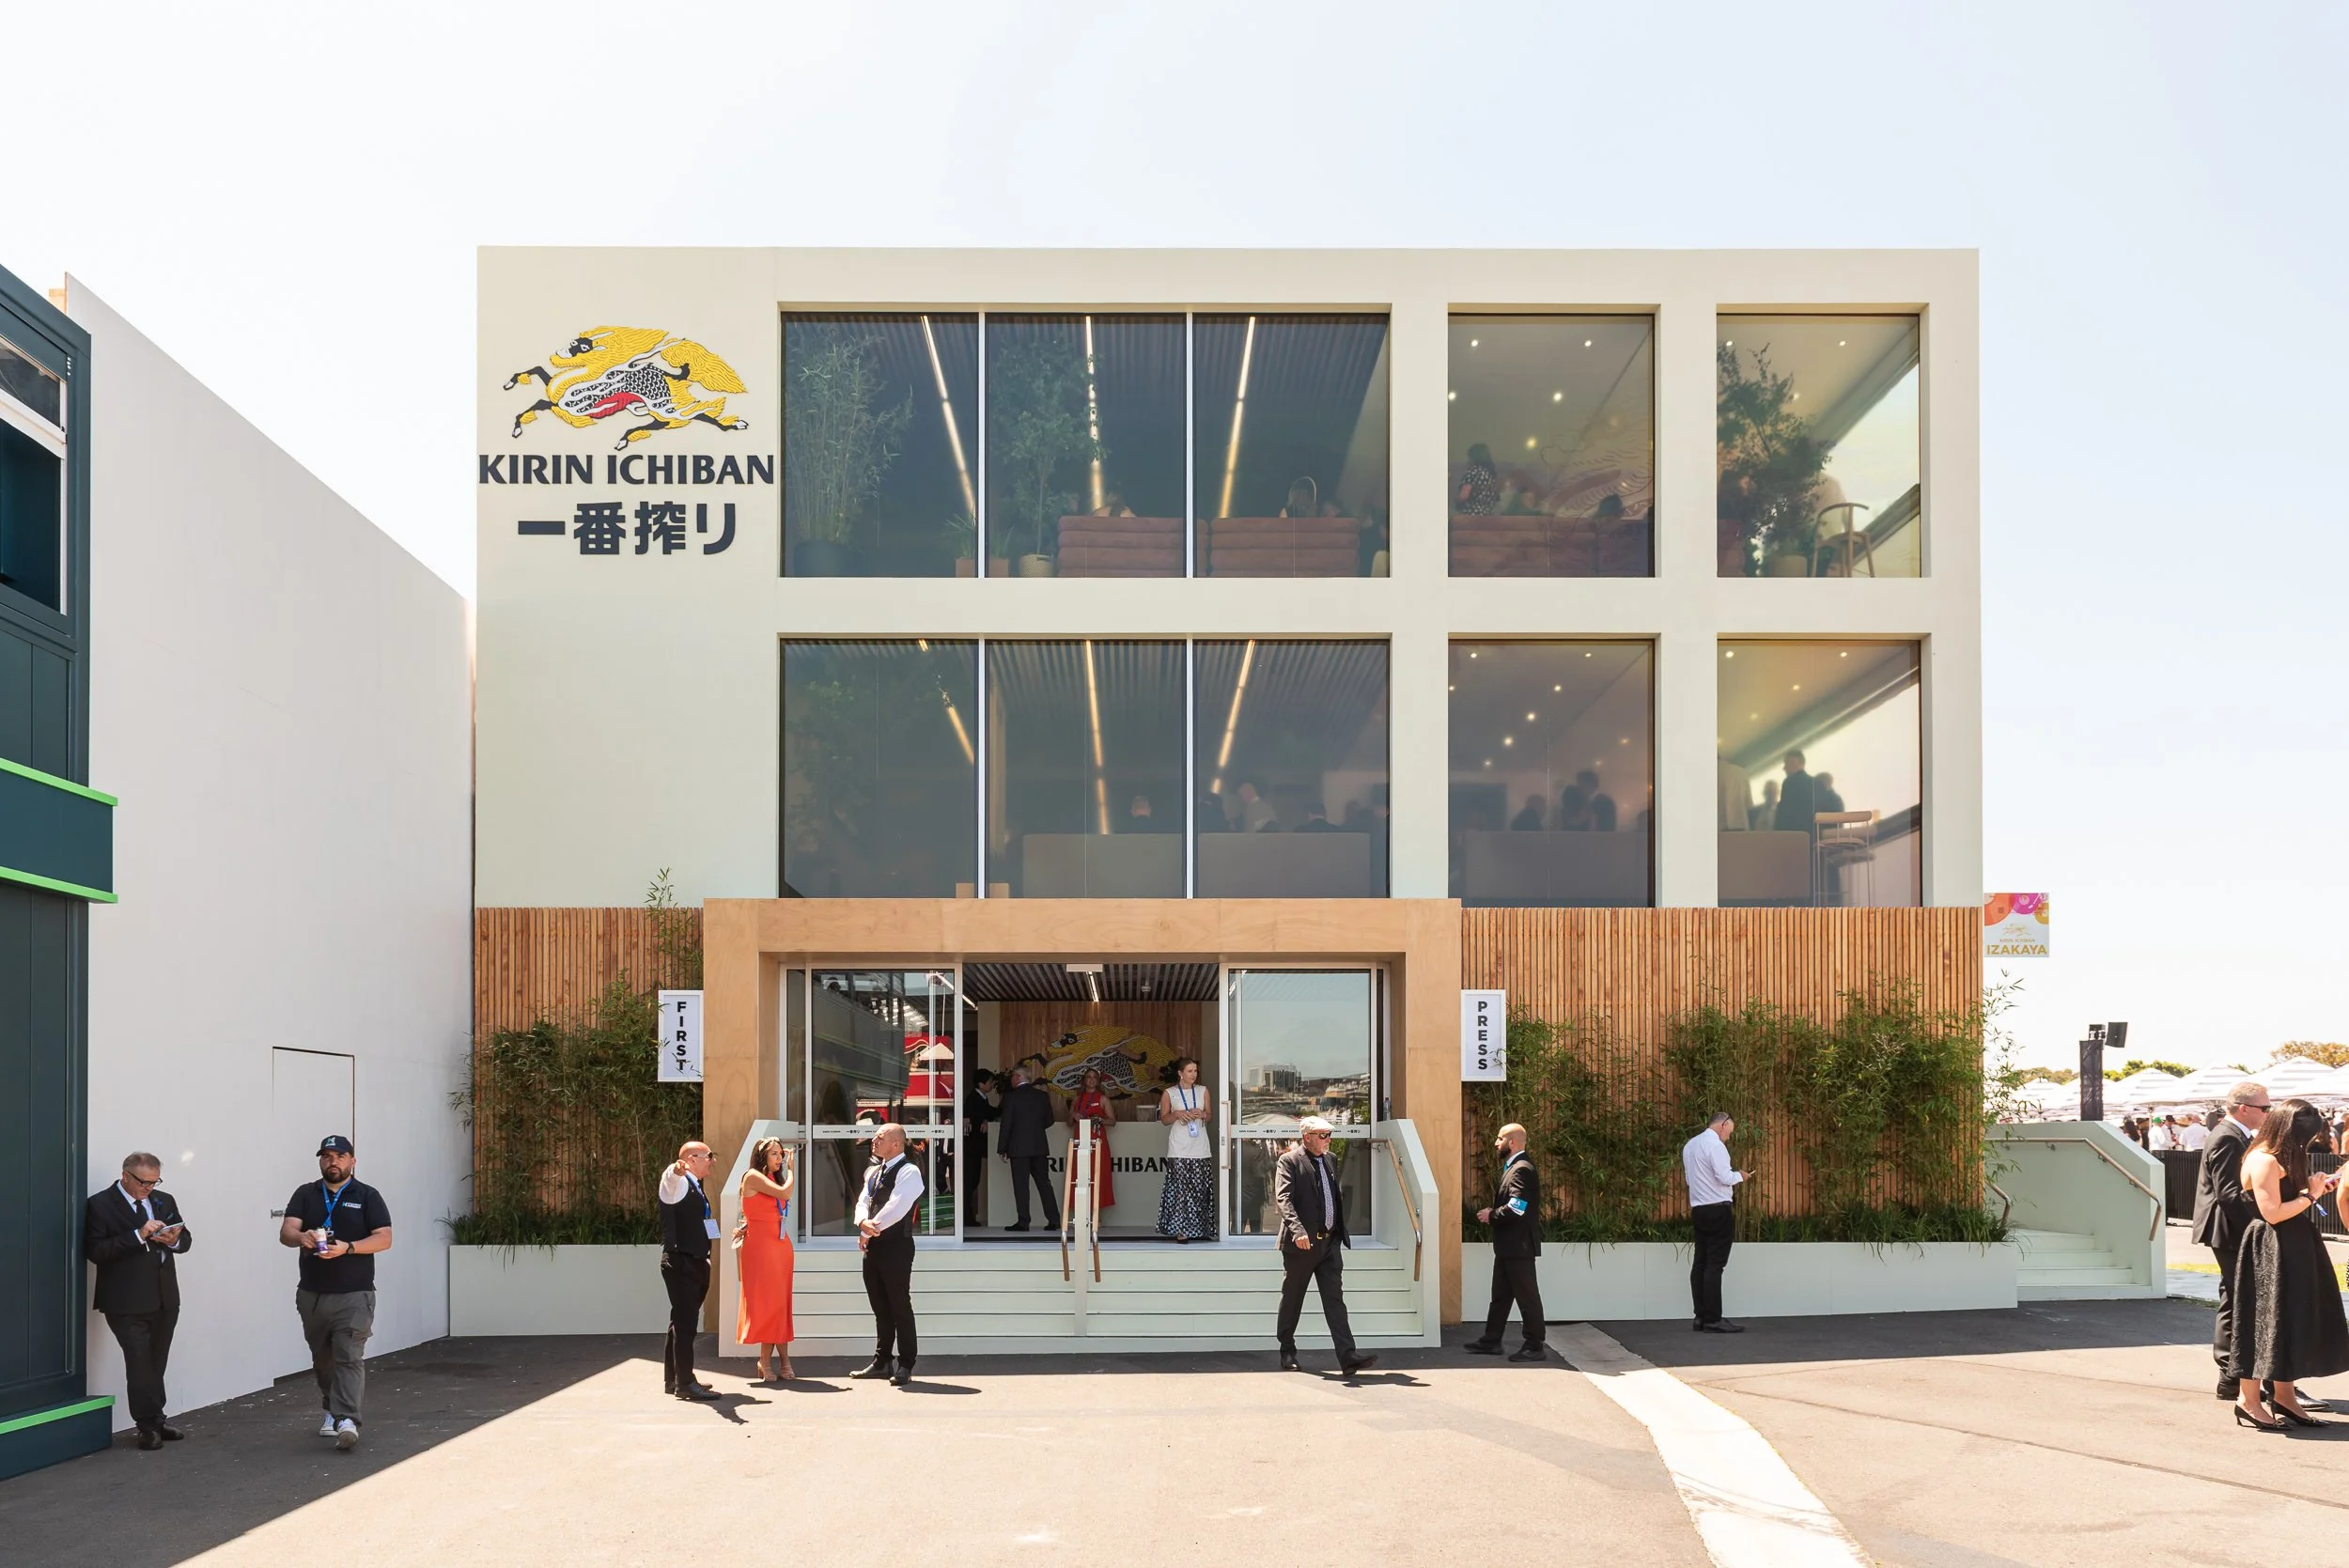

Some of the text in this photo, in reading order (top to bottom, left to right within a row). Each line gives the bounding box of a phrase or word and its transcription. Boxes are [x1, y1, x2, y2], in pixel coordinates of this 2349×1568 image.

[479, 455, 774, 485] KIRIN ICHIBAN
[1986, 944, 2047, 955] IZAKAYA
[677, 1001, 688, 1071] FIRST
[1477, 1001, 1488, 1070] PRESS
[1111, 1157, 1168, 1172] HIBAN
